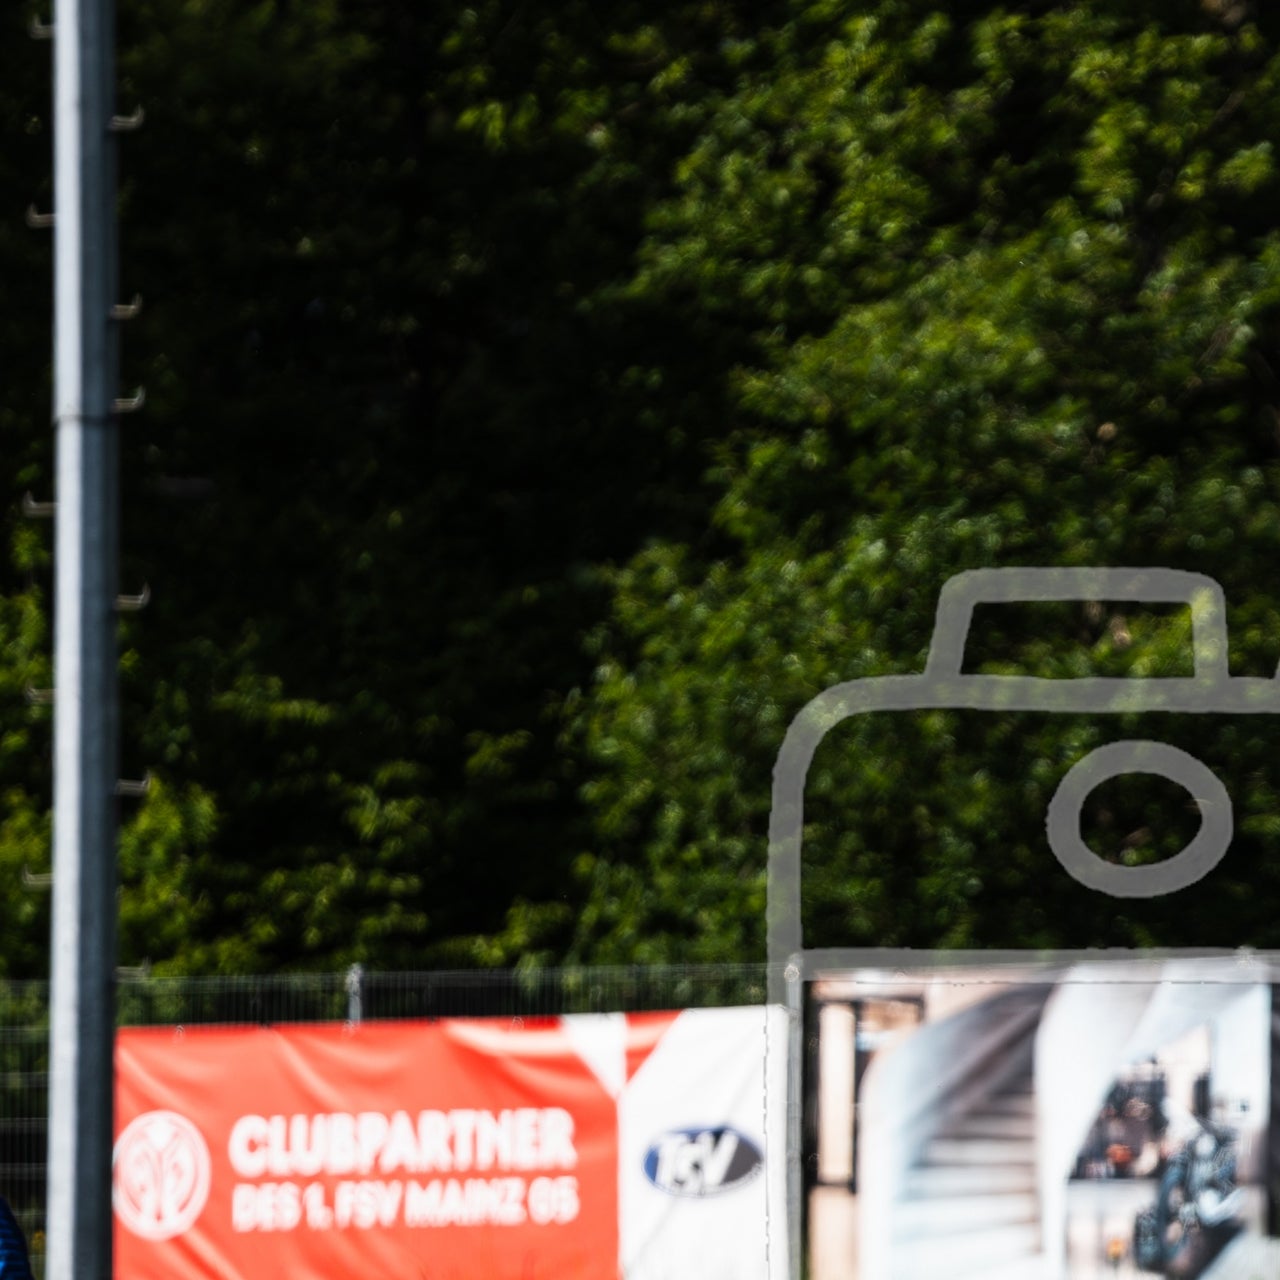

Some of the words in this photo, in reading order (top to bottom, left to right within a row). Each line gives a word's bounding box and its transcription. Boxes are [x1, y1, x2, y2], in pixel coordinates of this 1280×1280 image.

[229, 1108, 578, 1177] CLUBPARTNER
[232, 1182, 300, 1232] DES
[303, 1182, 333, 1230] 1.
[335, 1180, 402, 1229] FSV
[404, 1177, 526, 1227] MAINZ
[528, 1175, 580, 1225] 05
